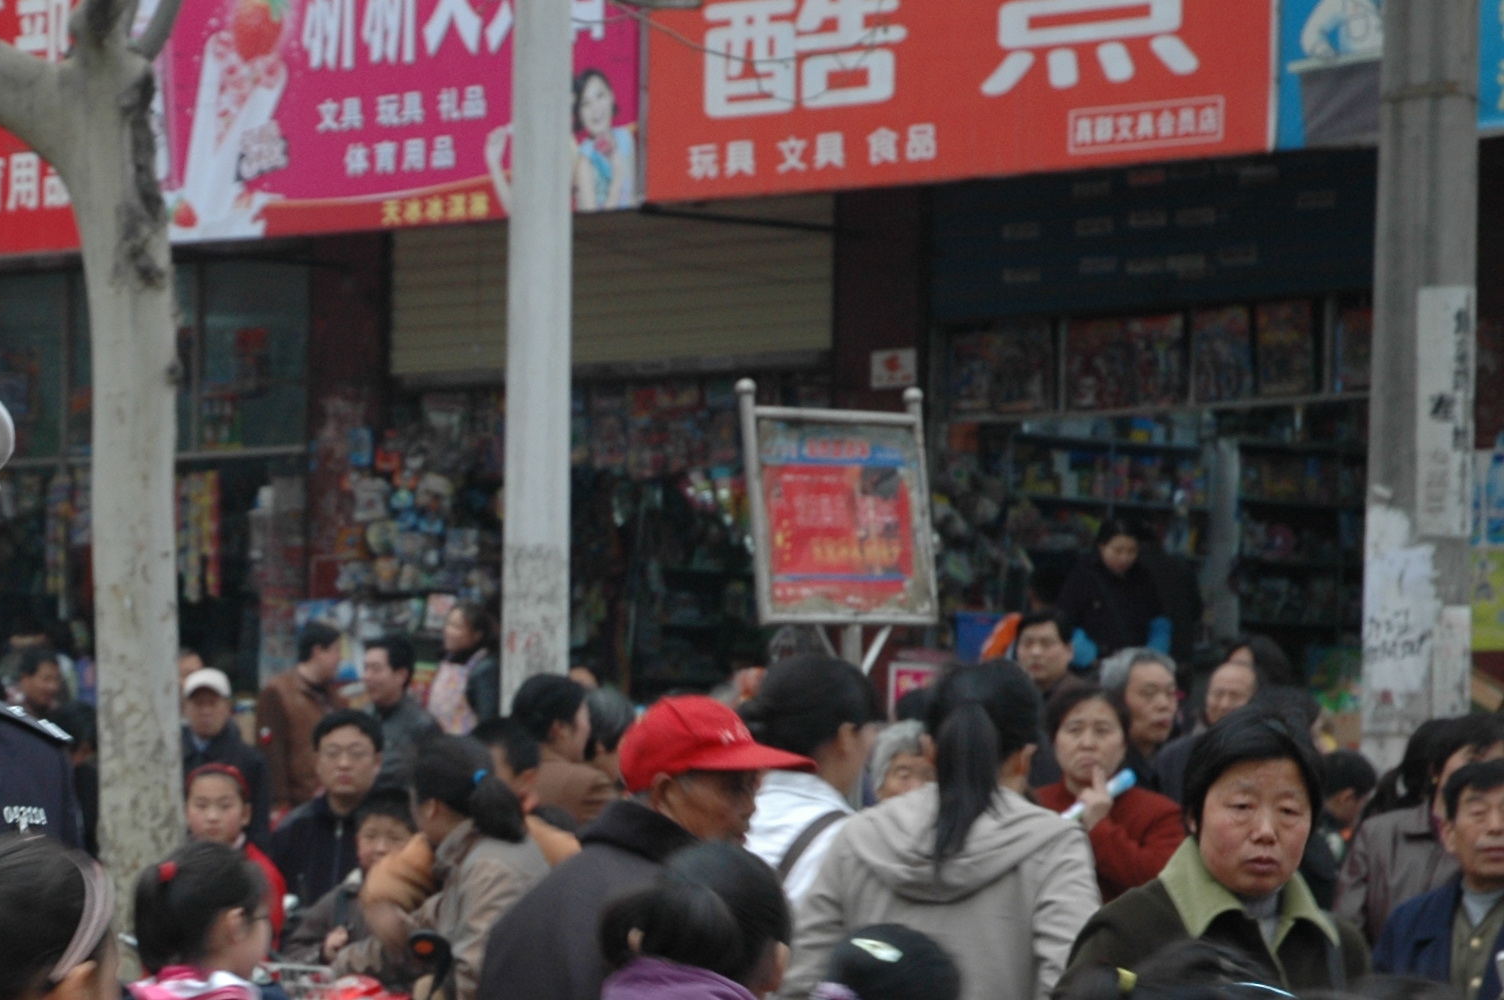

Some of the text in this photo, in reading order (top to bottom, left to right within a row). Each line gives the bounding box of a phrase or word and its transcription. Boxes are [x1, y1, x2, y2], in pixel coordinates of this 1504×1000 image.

[316, 84, 487, 133] 文具 玩具 礼品
[344, 134, 456, 178] 体育用品
[687, 122, 938, 181] 玩具 文具 食品
